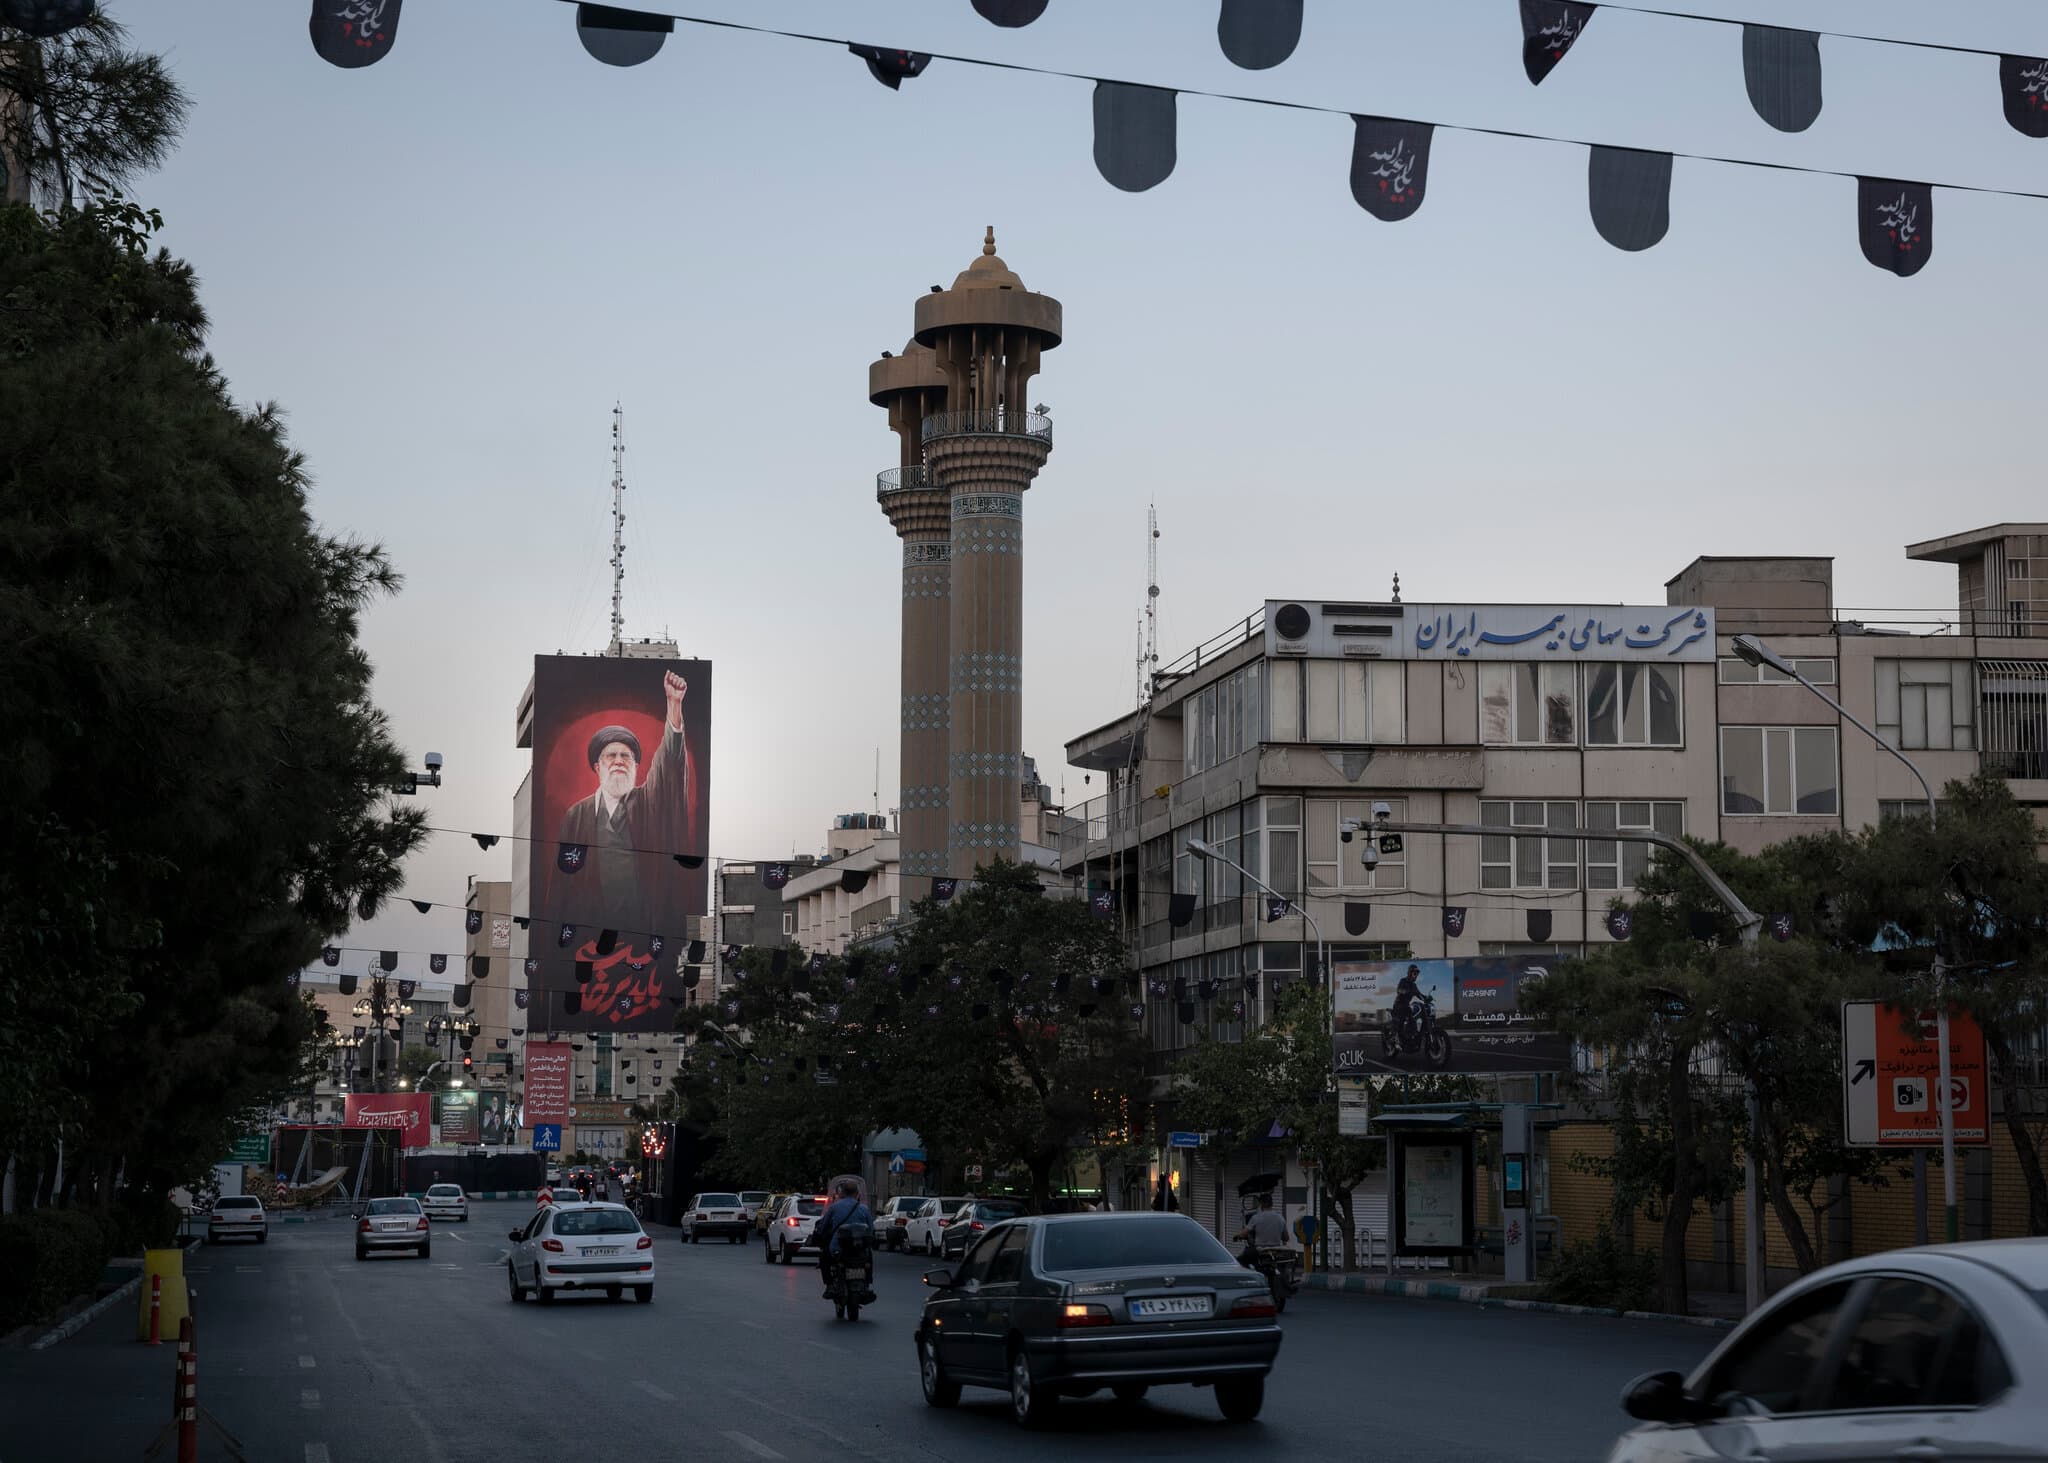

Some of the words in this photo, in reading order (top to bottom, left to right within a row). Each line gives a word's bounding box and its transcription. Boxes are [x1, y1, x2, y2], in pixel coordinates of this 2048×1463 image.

[1416, 611, 1475, 656] ایران
[1475, 613, 1566, 651] بیمه
[1569, 618, 1623, 651] سهامی
[1625, 608, 1707, 655] شرکت
[1462, 1009, 1506, 1025] همیشه
